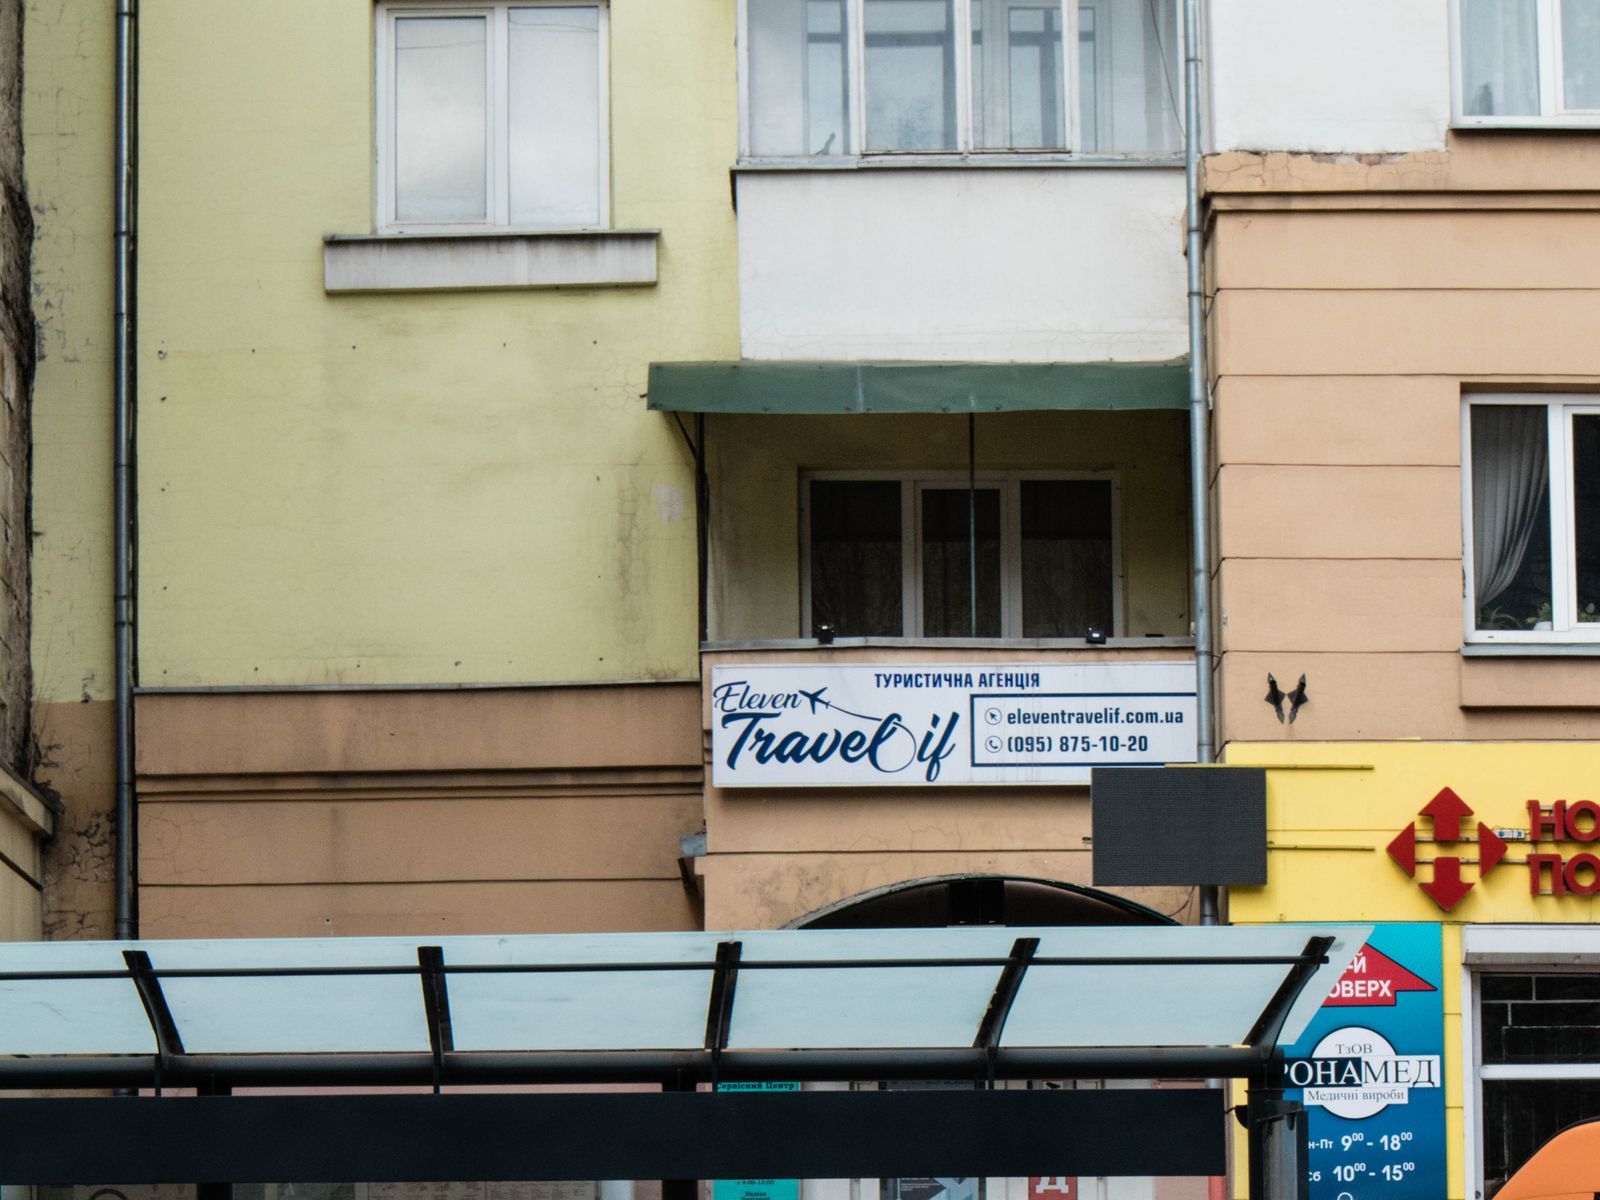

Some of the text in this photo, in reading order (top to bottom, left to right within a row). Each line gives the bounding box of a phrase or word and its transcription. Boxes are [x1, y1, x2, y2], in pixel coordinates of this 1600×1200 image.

[874, 672, 1040, 689] ТУРИСТИЧНА АГЕНЦІЯ
[713, 681, 801, 713] Eleven
[1007, 707, 1184, 725] eleventravelif.com.ua
[721, 711, 960, 782] Travel if
[1007, 735, 1149, 753] (095) 875-10-20
[1328, 980, 1392, 998] ОВЕРХ
[1284, 1059, 1435, 1088] ОНАМЕД
[1308, 1089, 1405, 1103] Медичні вироби
